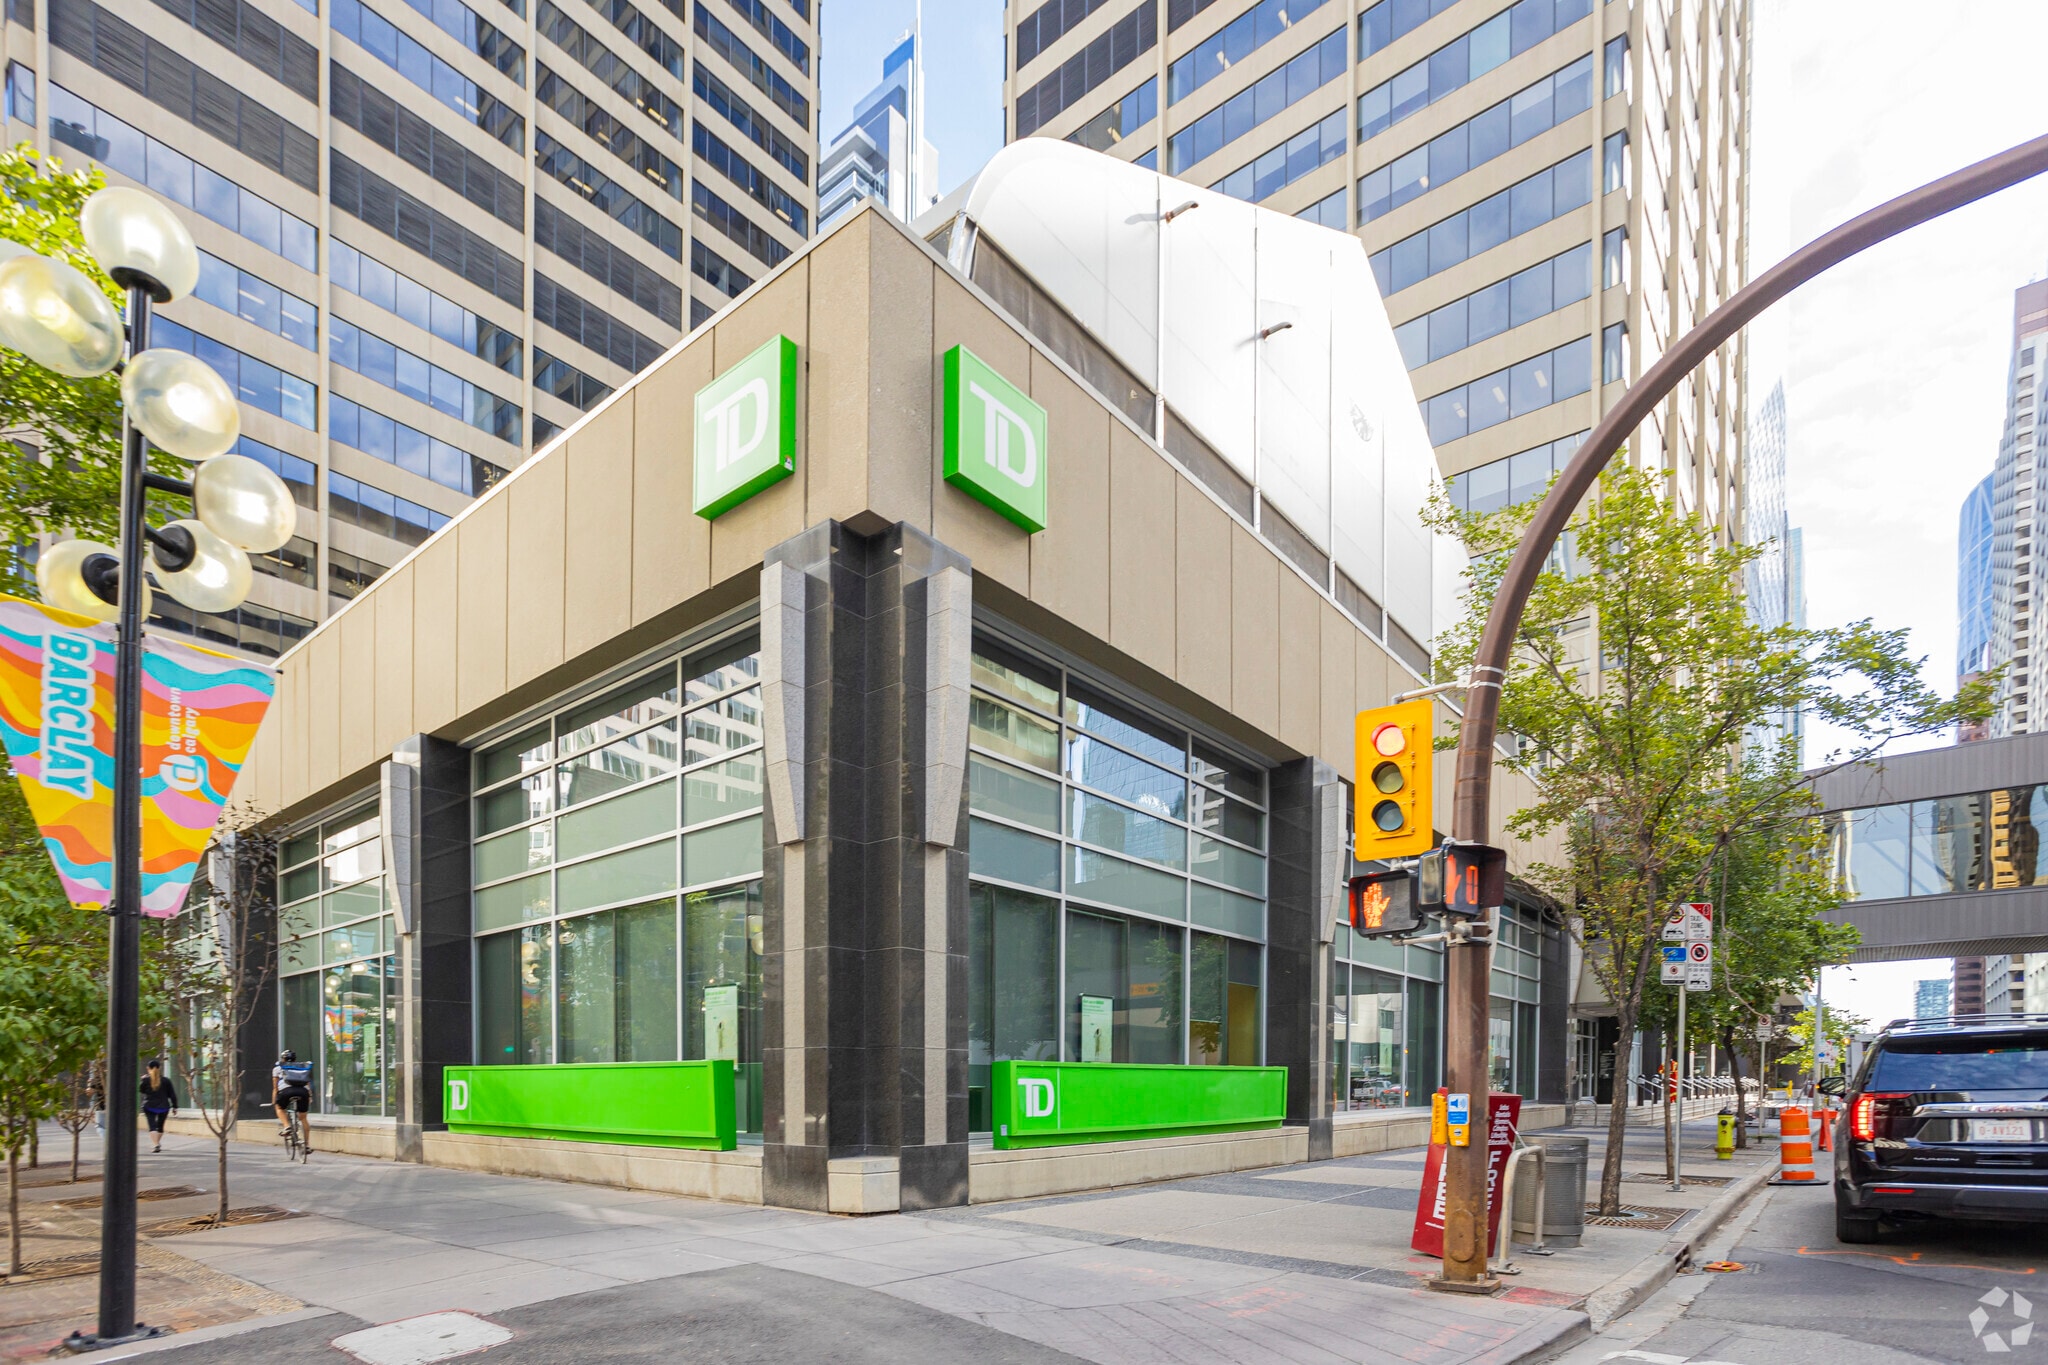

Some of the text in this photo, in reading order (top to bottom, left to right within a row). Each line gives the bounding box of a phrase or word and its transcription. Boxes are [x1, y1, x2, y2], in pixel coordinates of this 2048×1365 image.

[704, 377, 769, 473] TD
[969, 380, 1037, 488] TD
[45, 632, 91, 796] BARCLAY
[166, 686, 182, 751] downtown
[182, 706, 201, 754] calgary
[448, 1080, 468, 1111] TD
[1017, 1078, 1055, 1118] TD
